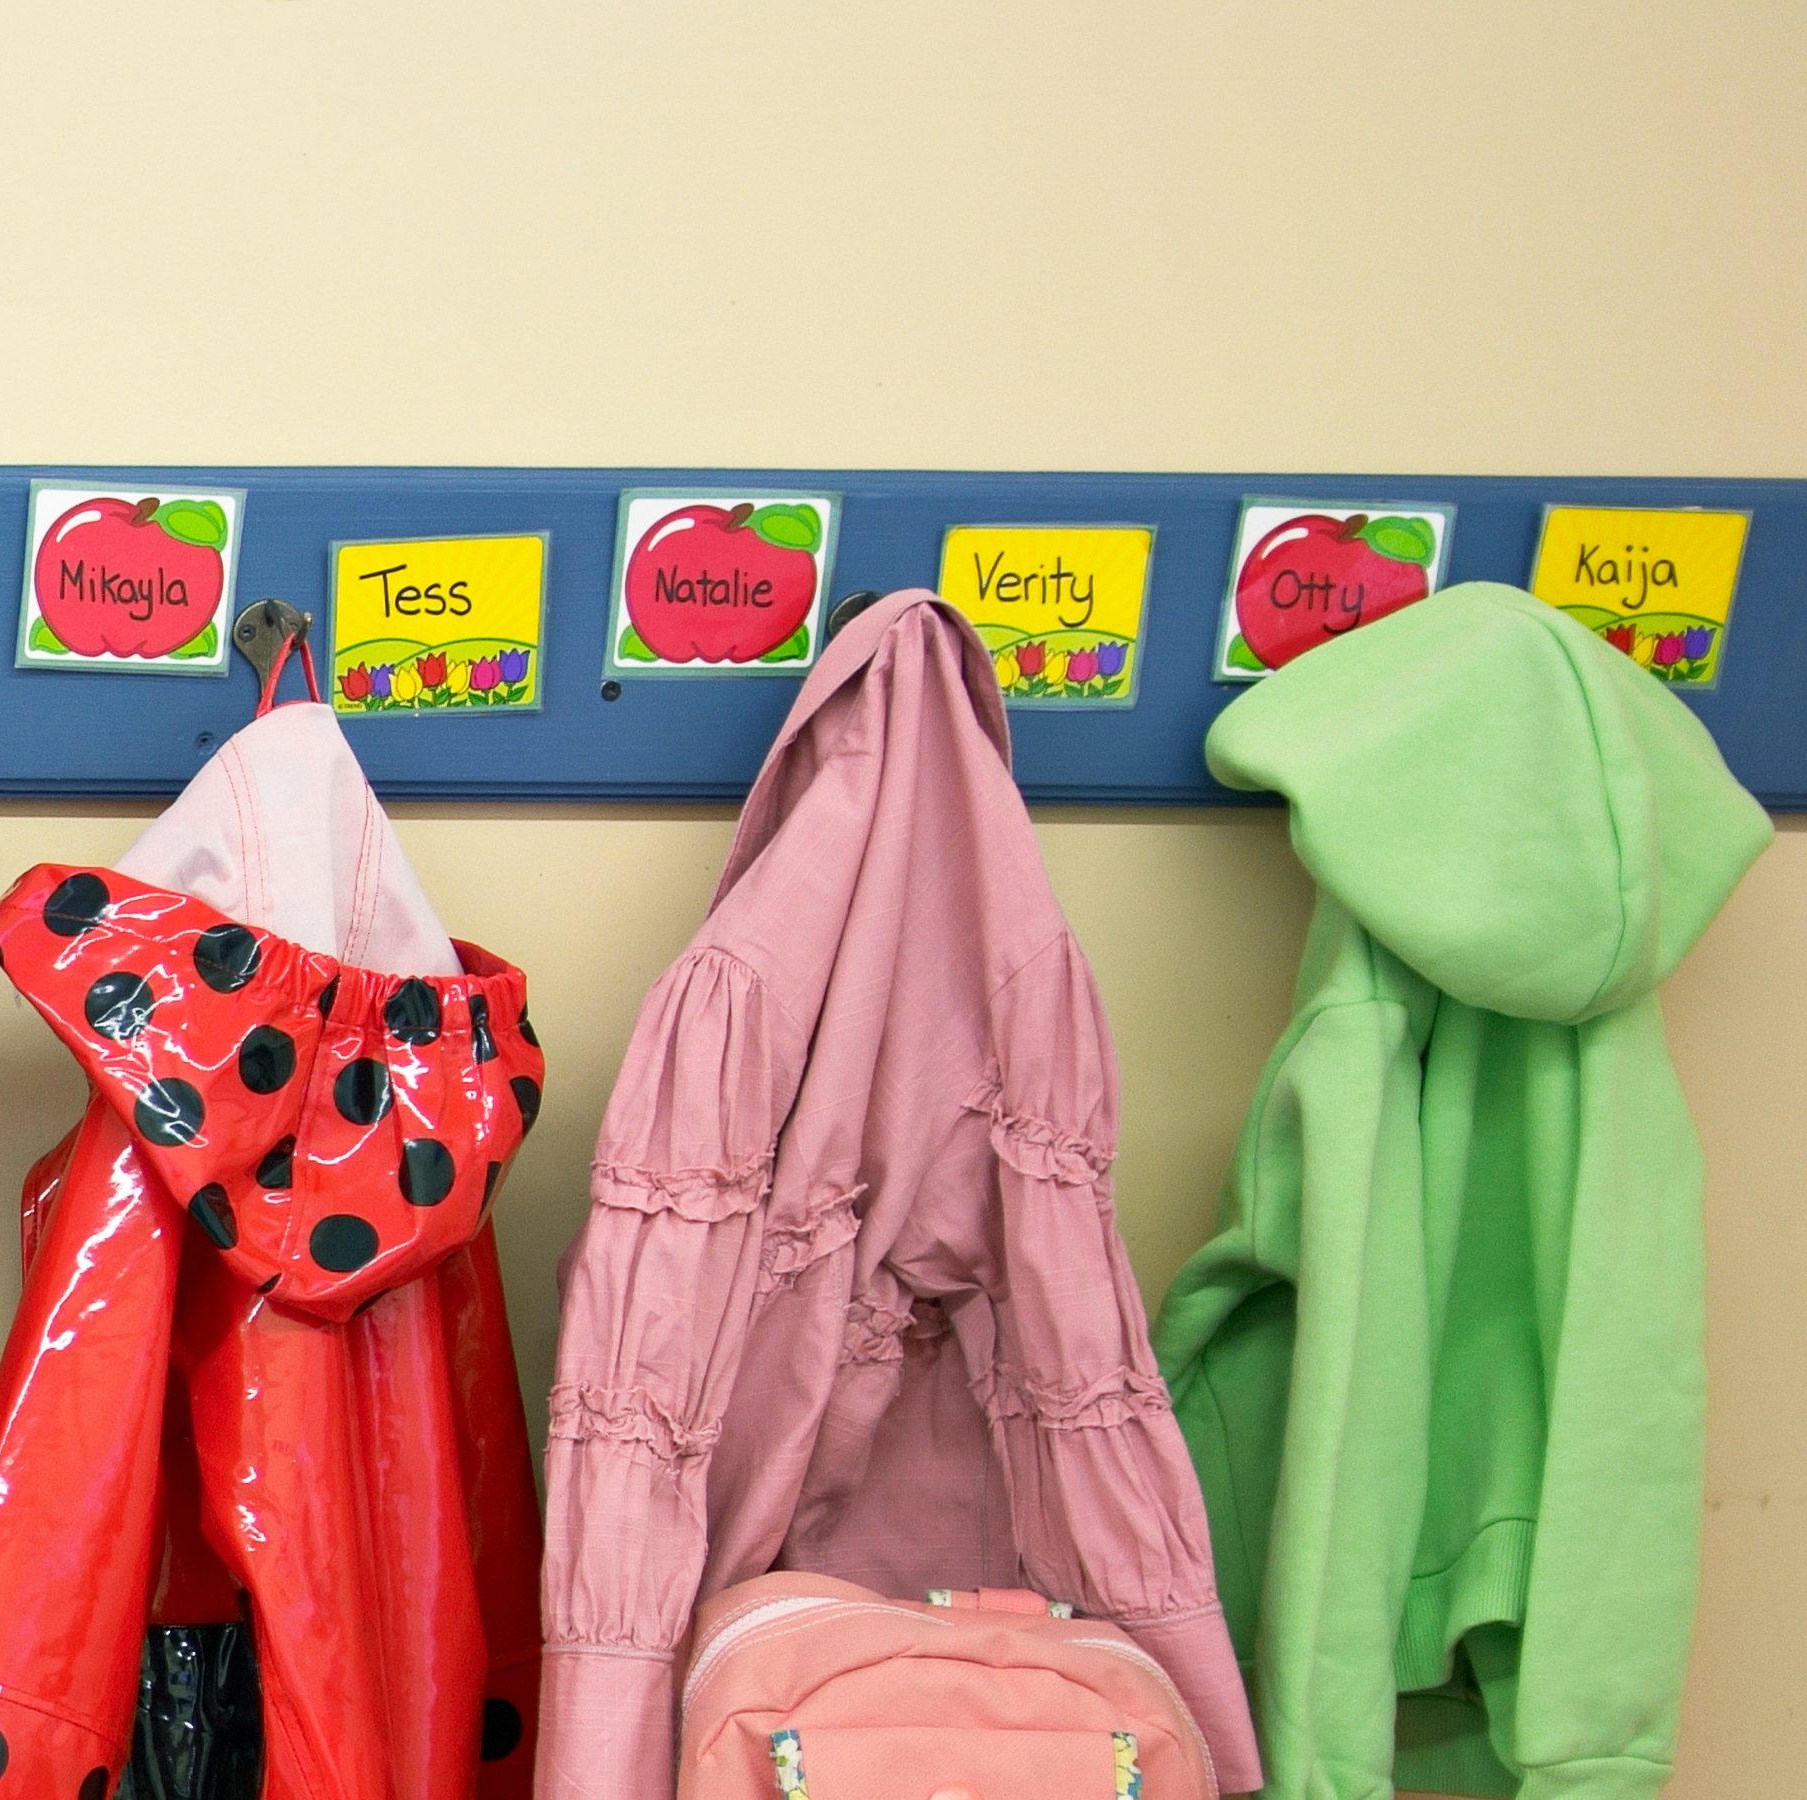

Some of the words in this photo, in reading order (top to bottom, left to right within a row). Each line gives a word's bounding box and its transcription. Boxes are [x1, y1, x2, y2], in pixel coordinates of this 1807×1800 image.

[59, 560, 189, 622] Mikayla
[359, 564, 472, 618] Tess
[653, 569, 774, 608] Natalie
[974, 552, 1094, 628] Verity
[1270, 570, 1364, 633] Otty
[1574, 544, 1678, 609] Kaija
